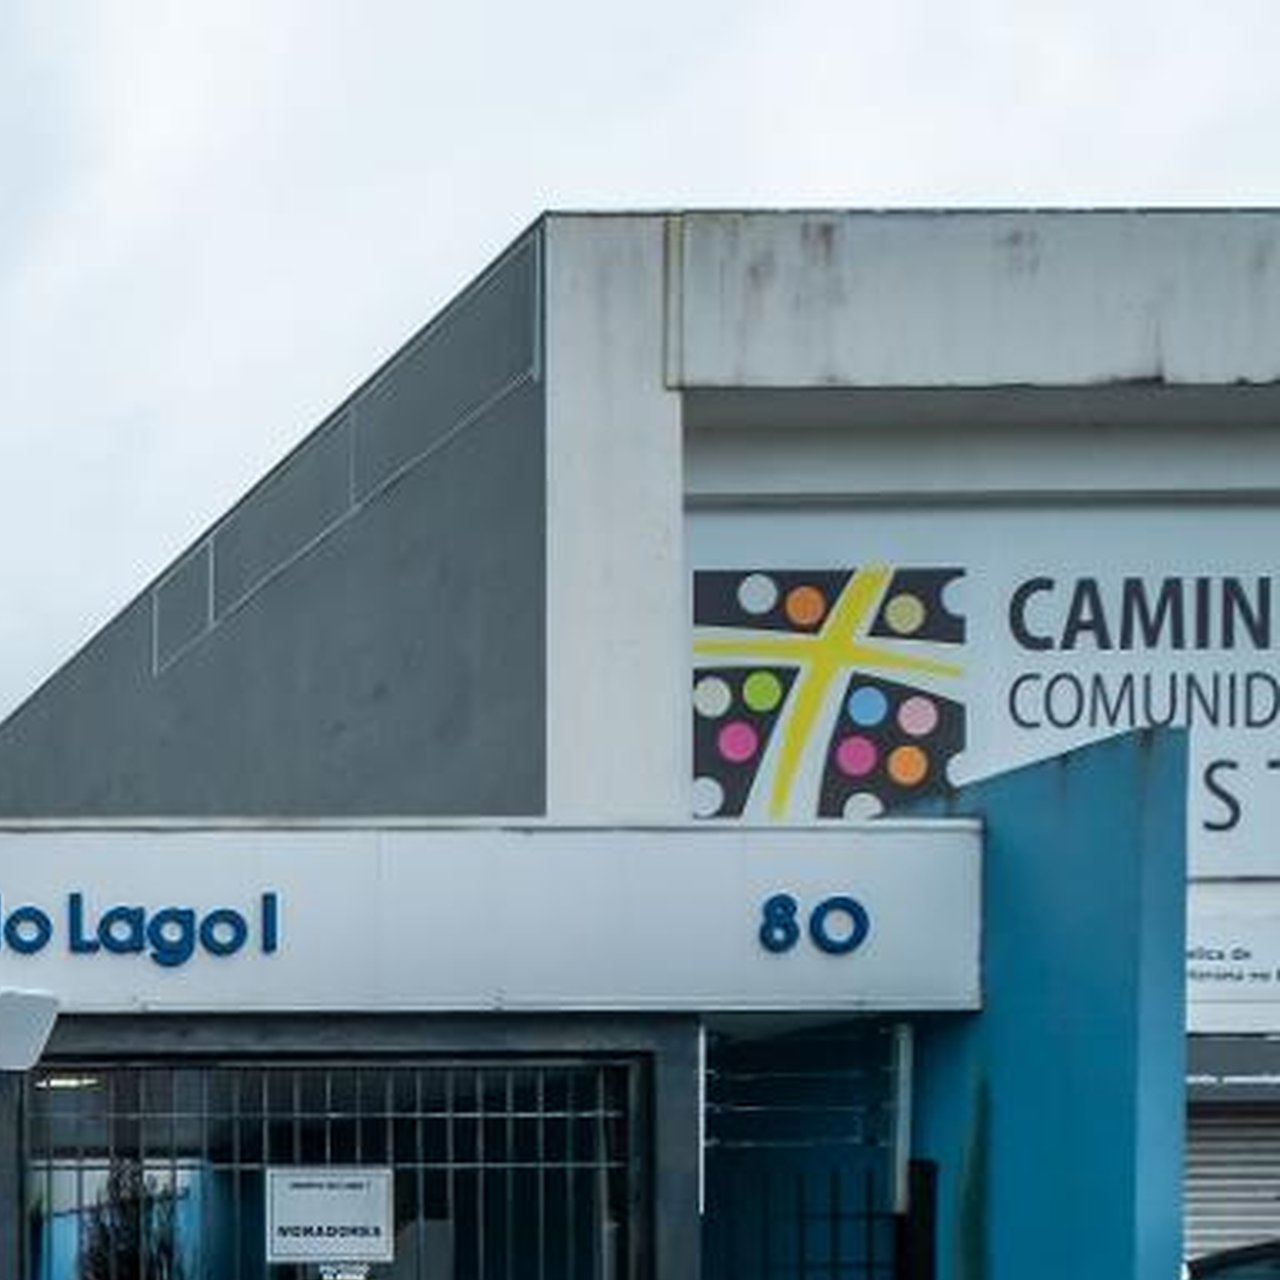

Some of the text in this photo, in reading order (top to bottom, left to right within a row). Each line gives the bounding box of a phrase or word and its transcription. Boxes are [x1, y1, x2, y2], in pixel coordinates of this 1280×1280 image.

[1008, 576, 1272, 651] CAMIN
[1008, 671, 1280, 729] COMUNID
[68, 892, 248, 967] Lago
[758, 893, 870, 956] 80
